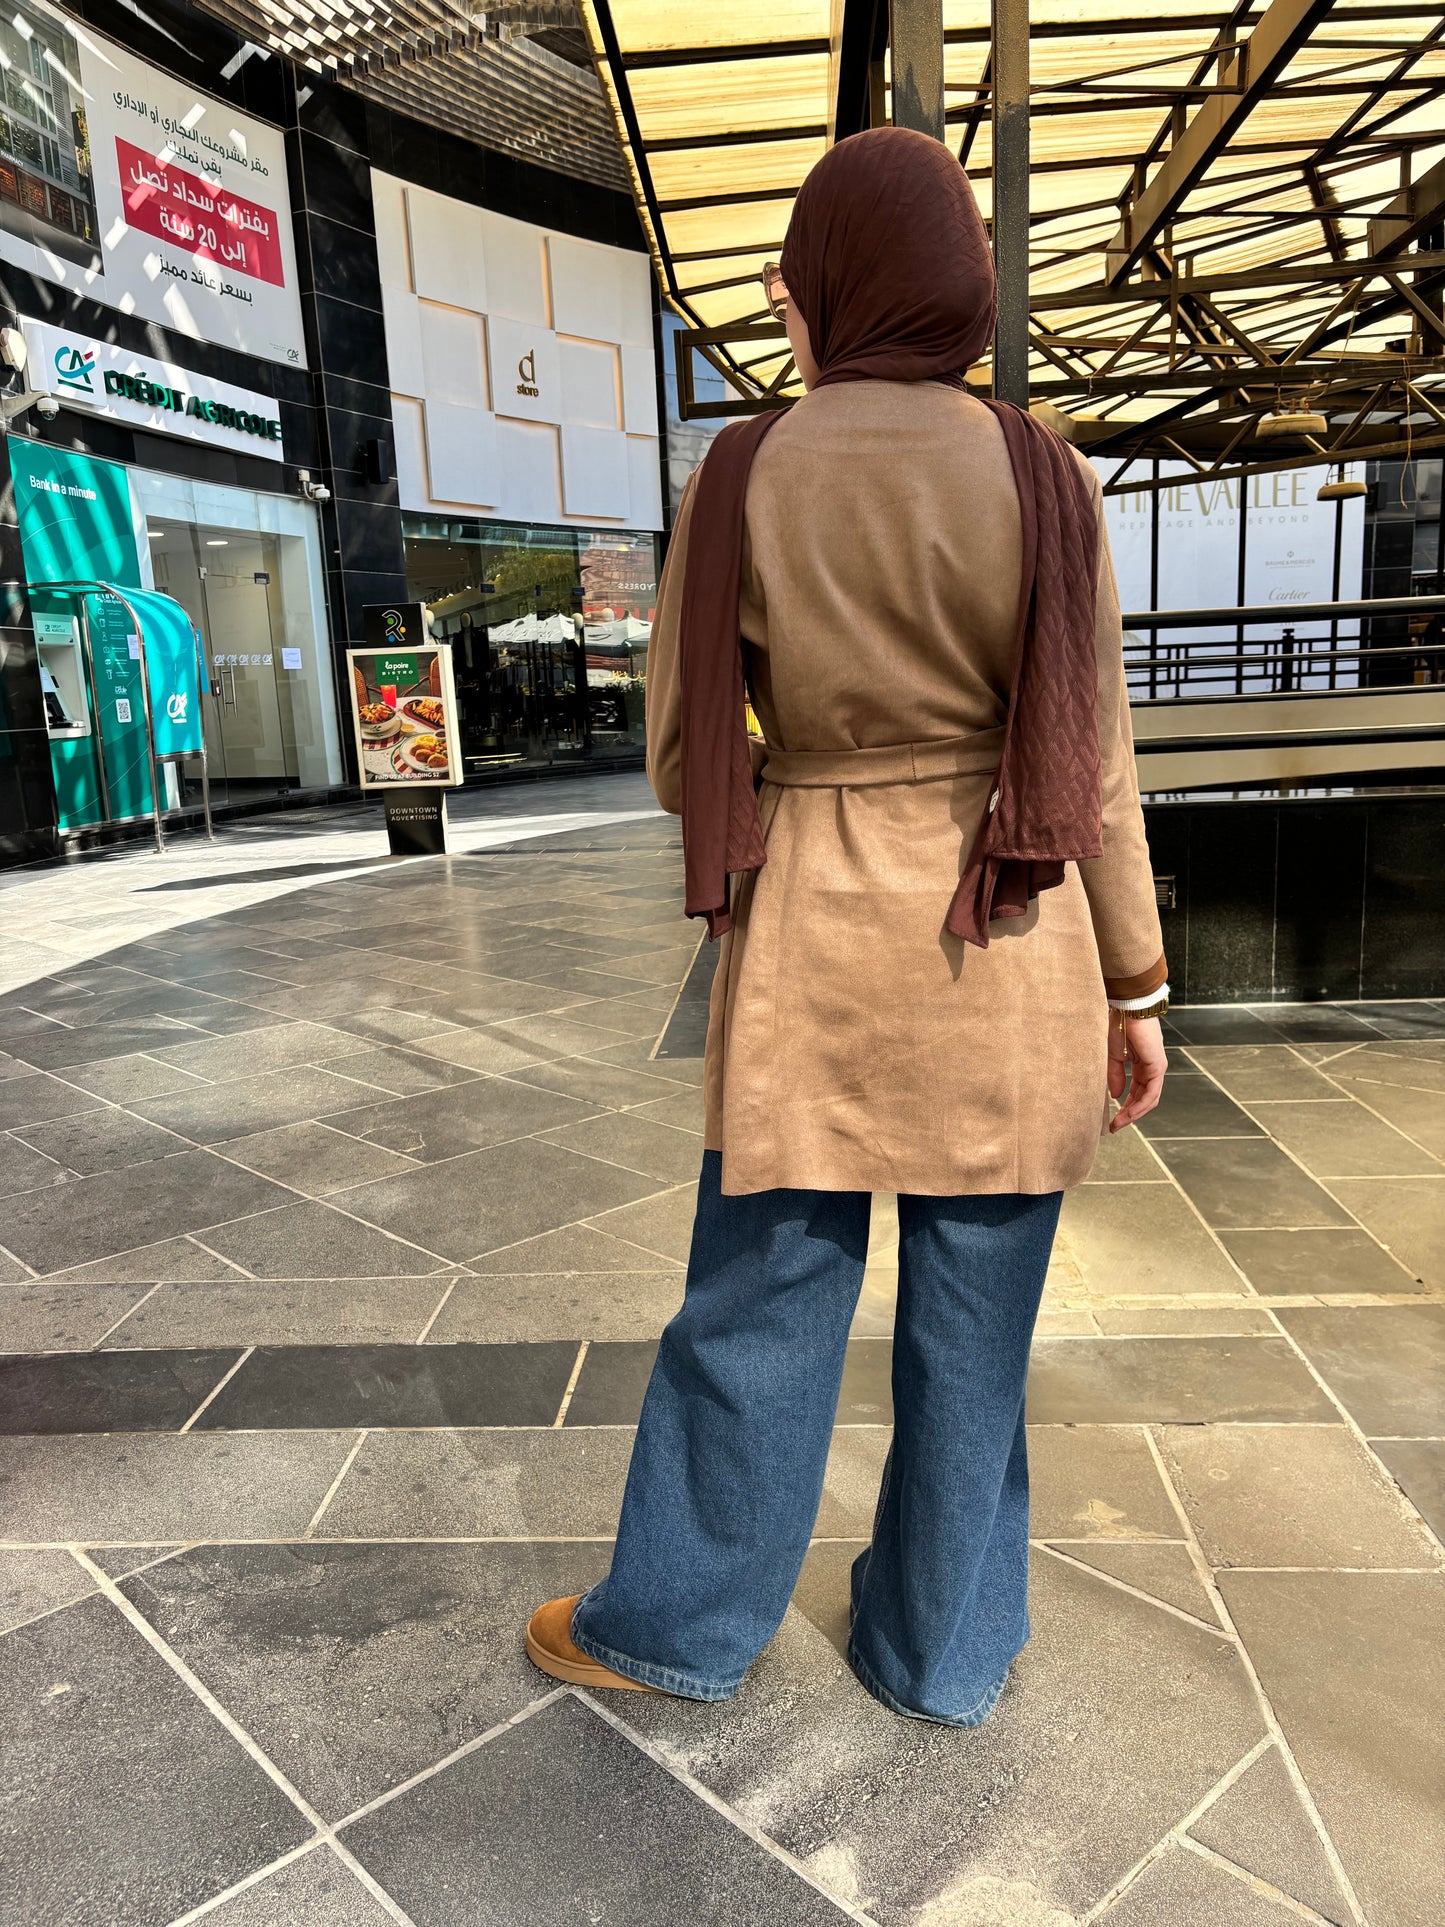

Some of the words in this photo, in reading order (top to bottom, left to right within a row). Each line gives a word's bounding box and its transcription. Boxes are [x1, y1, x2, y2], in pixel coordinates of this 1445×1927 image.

[113, 91, 147, 118] الإداري
[150, 106, 159, 124] أو
[161, 117, 199, 143] التجاري
[200, 135, 248, 167] مشروعك
[130, 160, 169, 192] تصل
[250, 158, 269, 176] مقر
[172, 181, 214, 212] سداد
[159, 206, 195, 241] سنة
[216, 201, 270, 241] بفترات
[197, 223, 217, 250] 20
[159, 254, 188, 281] مميز
[220, 242, 247, 268] إلى
[191, 269, 216, 290] عائد
[219, 281, 253, 307] بسعر
[516, 383, 540, 398] store
[104, 368, 186, 413] CRÉDIT
[186, 396, 283, 441] AGRICOLE
[29, 475, 51, 492] Bank
[51, 480, 60, 494] in
[61, 484, 67, 495] a
[68, 485, 97, 501] minute
[1120, 519, 1193, 530] HERAGE
[1206, 518, 1236, 527] AND
[1248, 515, 1309, 525] BEYOND
[1268, 586, 1311, 601] Cartier
[390, 806, 438, 815] DOWNTOWN
[391, 813, 438, 822] ADVERTISING
